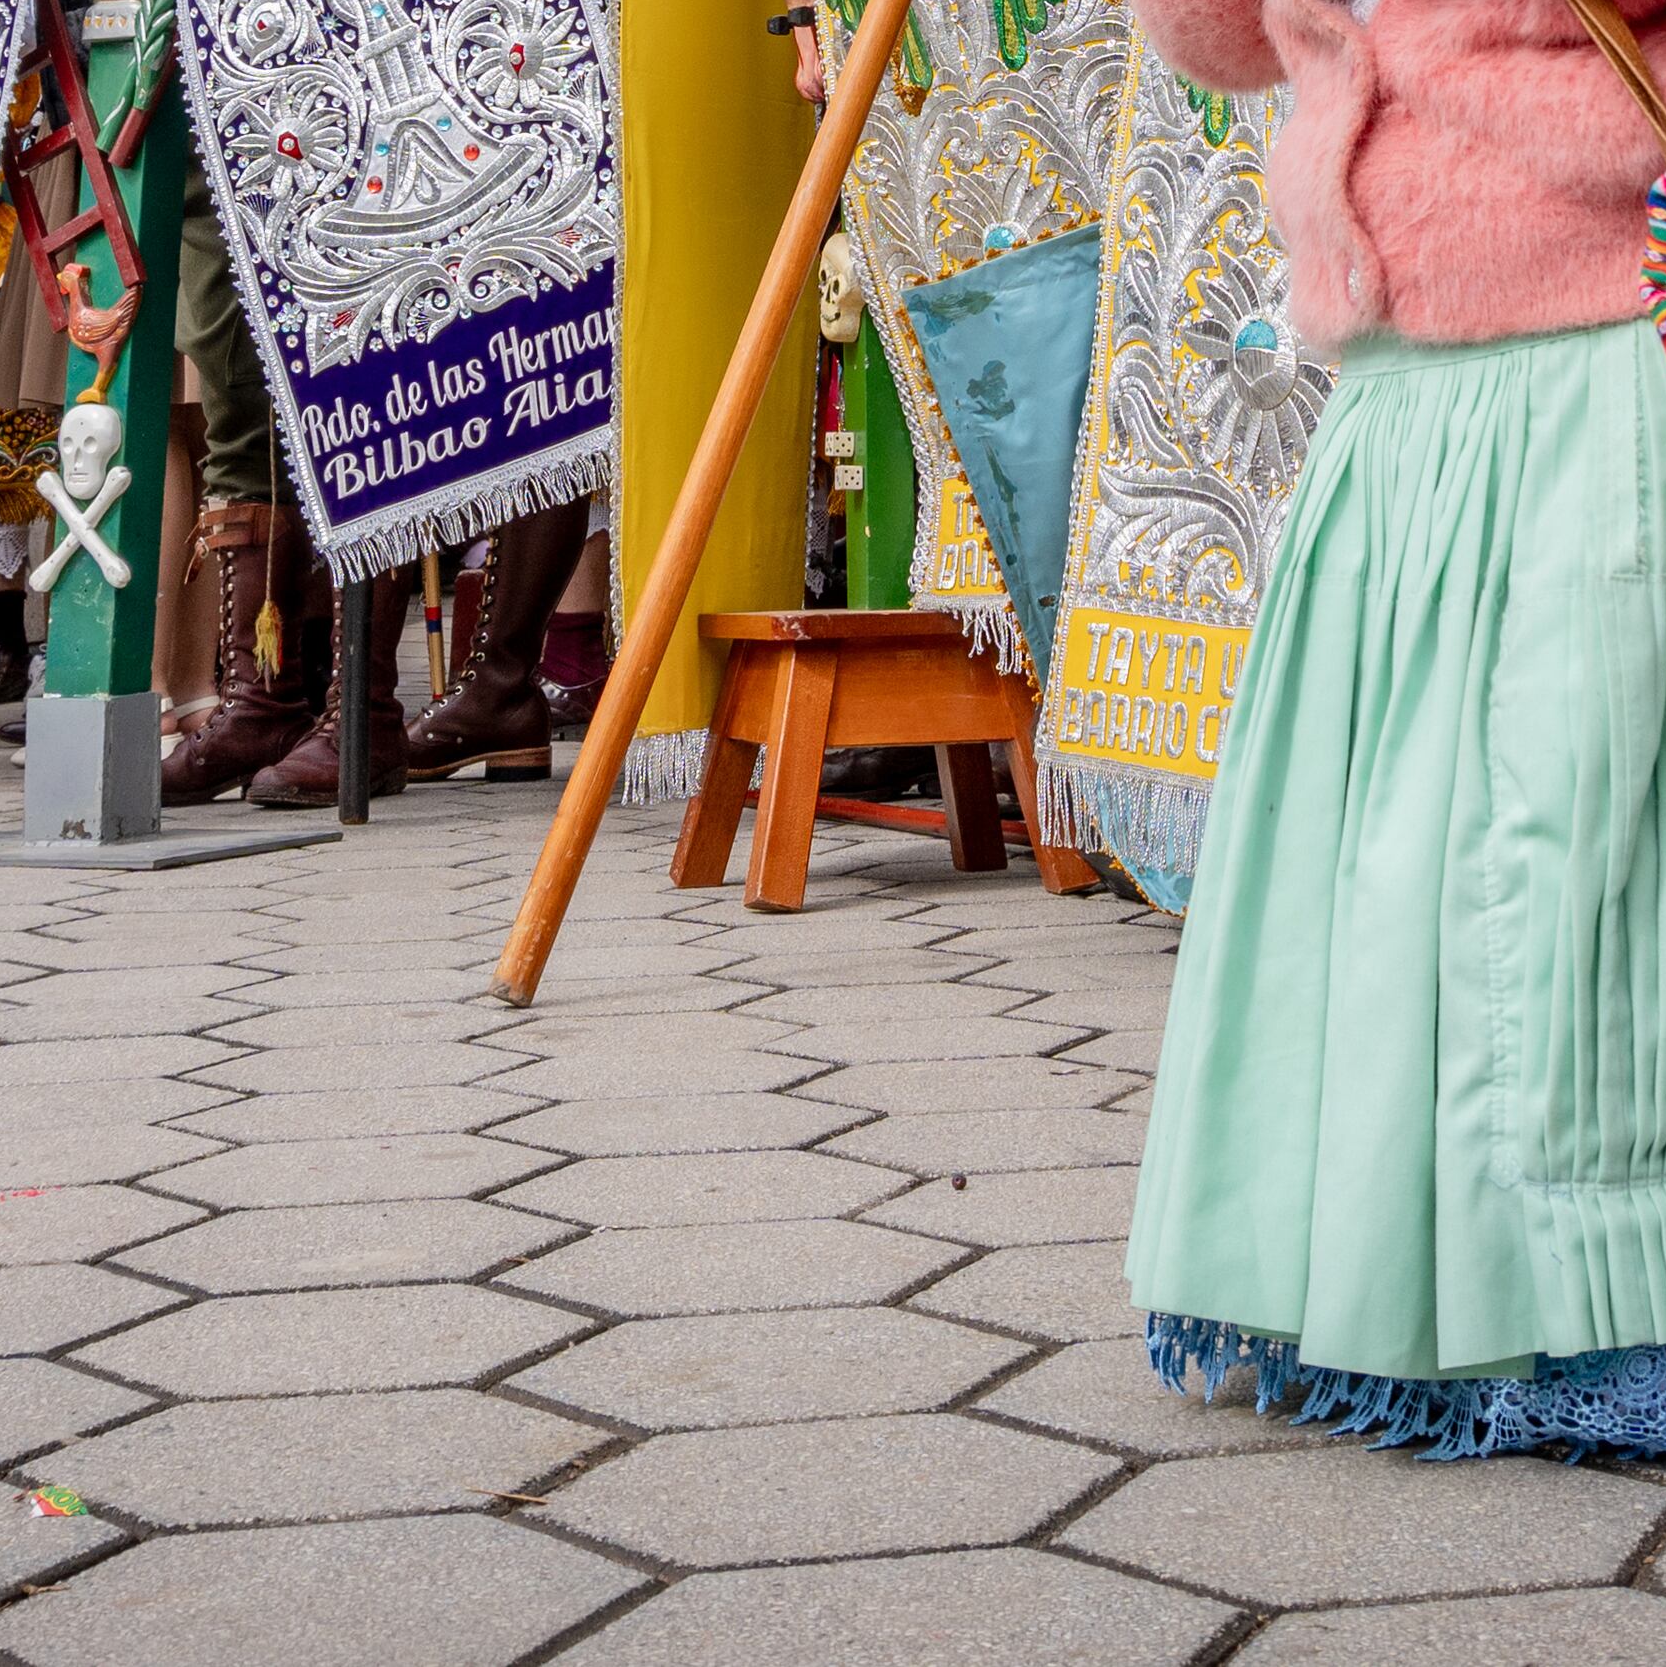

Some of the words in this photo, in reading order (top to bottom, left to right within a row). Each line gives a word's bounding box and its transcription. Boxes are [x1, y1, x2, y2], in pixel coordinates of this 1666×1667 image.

[300, 396, 381, 458] Rdo.
[385, 373, 428, 426] de
[427, 359, 486, 409] las
[323, 416, 492, 500] Bilbao
[1086, 622, 1207, 695] TAYTA
[1059, 686, 1189, 759] BARRIO
